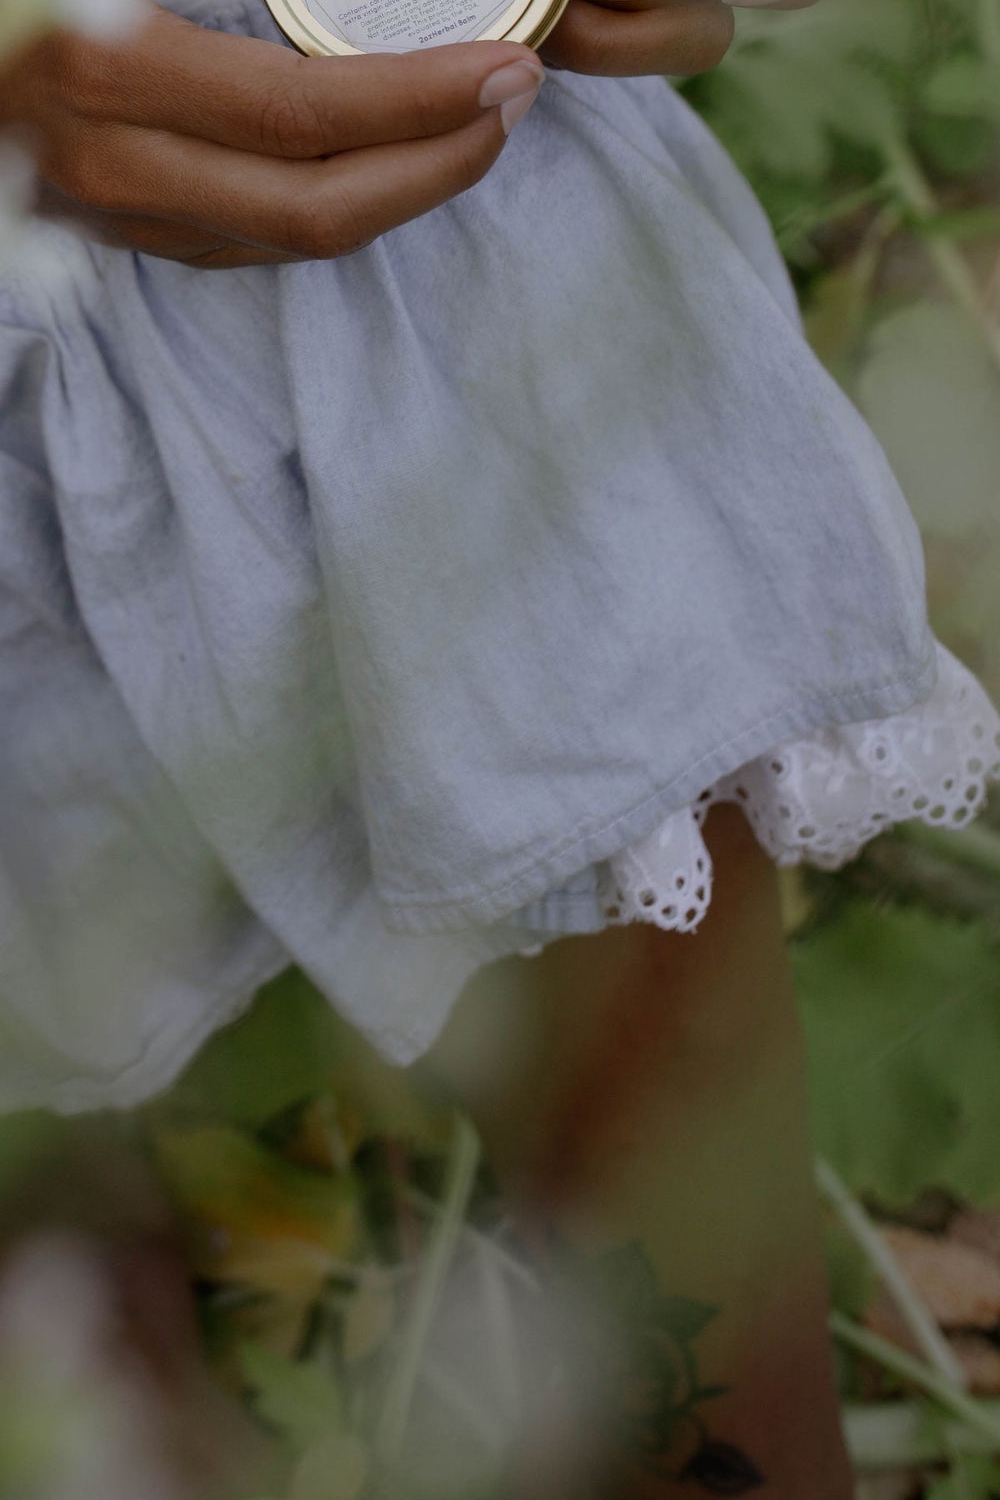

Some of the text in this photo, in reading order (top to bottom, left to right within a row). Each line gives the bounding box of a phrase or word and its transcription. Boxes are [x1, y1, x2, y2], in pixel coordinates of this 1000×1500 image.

[343, 14, 362, 25] extra
[362, 4, 383, 17] virgin
[457, 14, 476, 26] Balm
